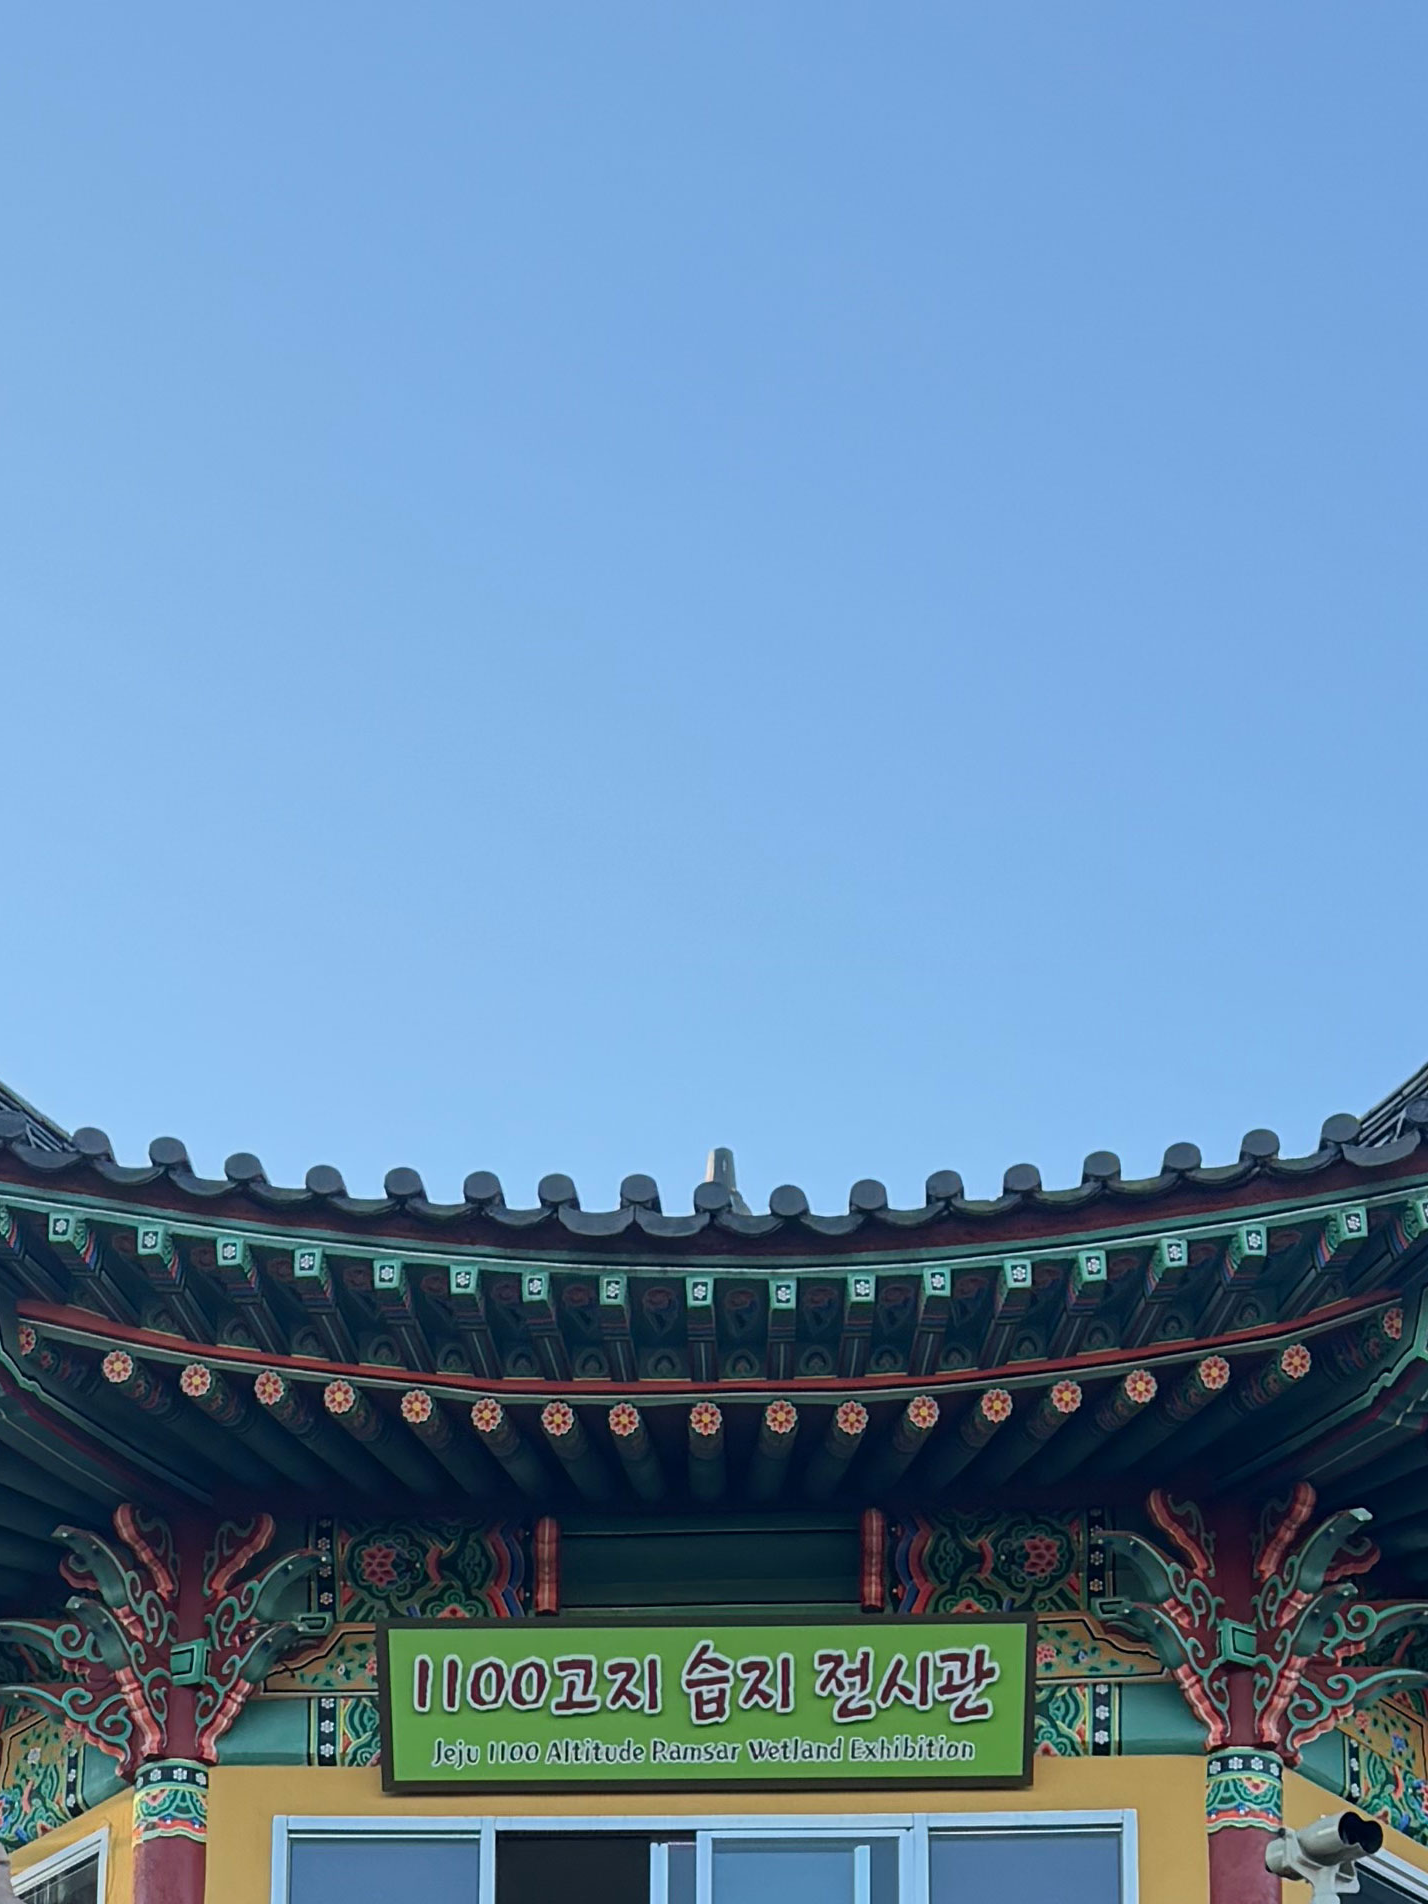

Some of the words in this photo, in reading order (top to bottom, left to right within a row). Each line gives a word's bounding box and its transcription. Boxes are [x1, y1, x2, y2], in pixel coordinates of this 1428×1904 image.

[414, 1652, 661, 1716] 1100고지
[683, 1640, 793, 1725] 습지
[814, 1644, 998, 1722] 전시관
[432, 1737, 481, 1767] Jeju
[486, 1739, 540, 1764] 1100
[544, 1738, 645, 1765] Altitude
[651, 1739, 741, 1764] Ramsar
[748, 1738, 843, 1763] Wetland
[849, 1737, 976, 1763] Exhibition
